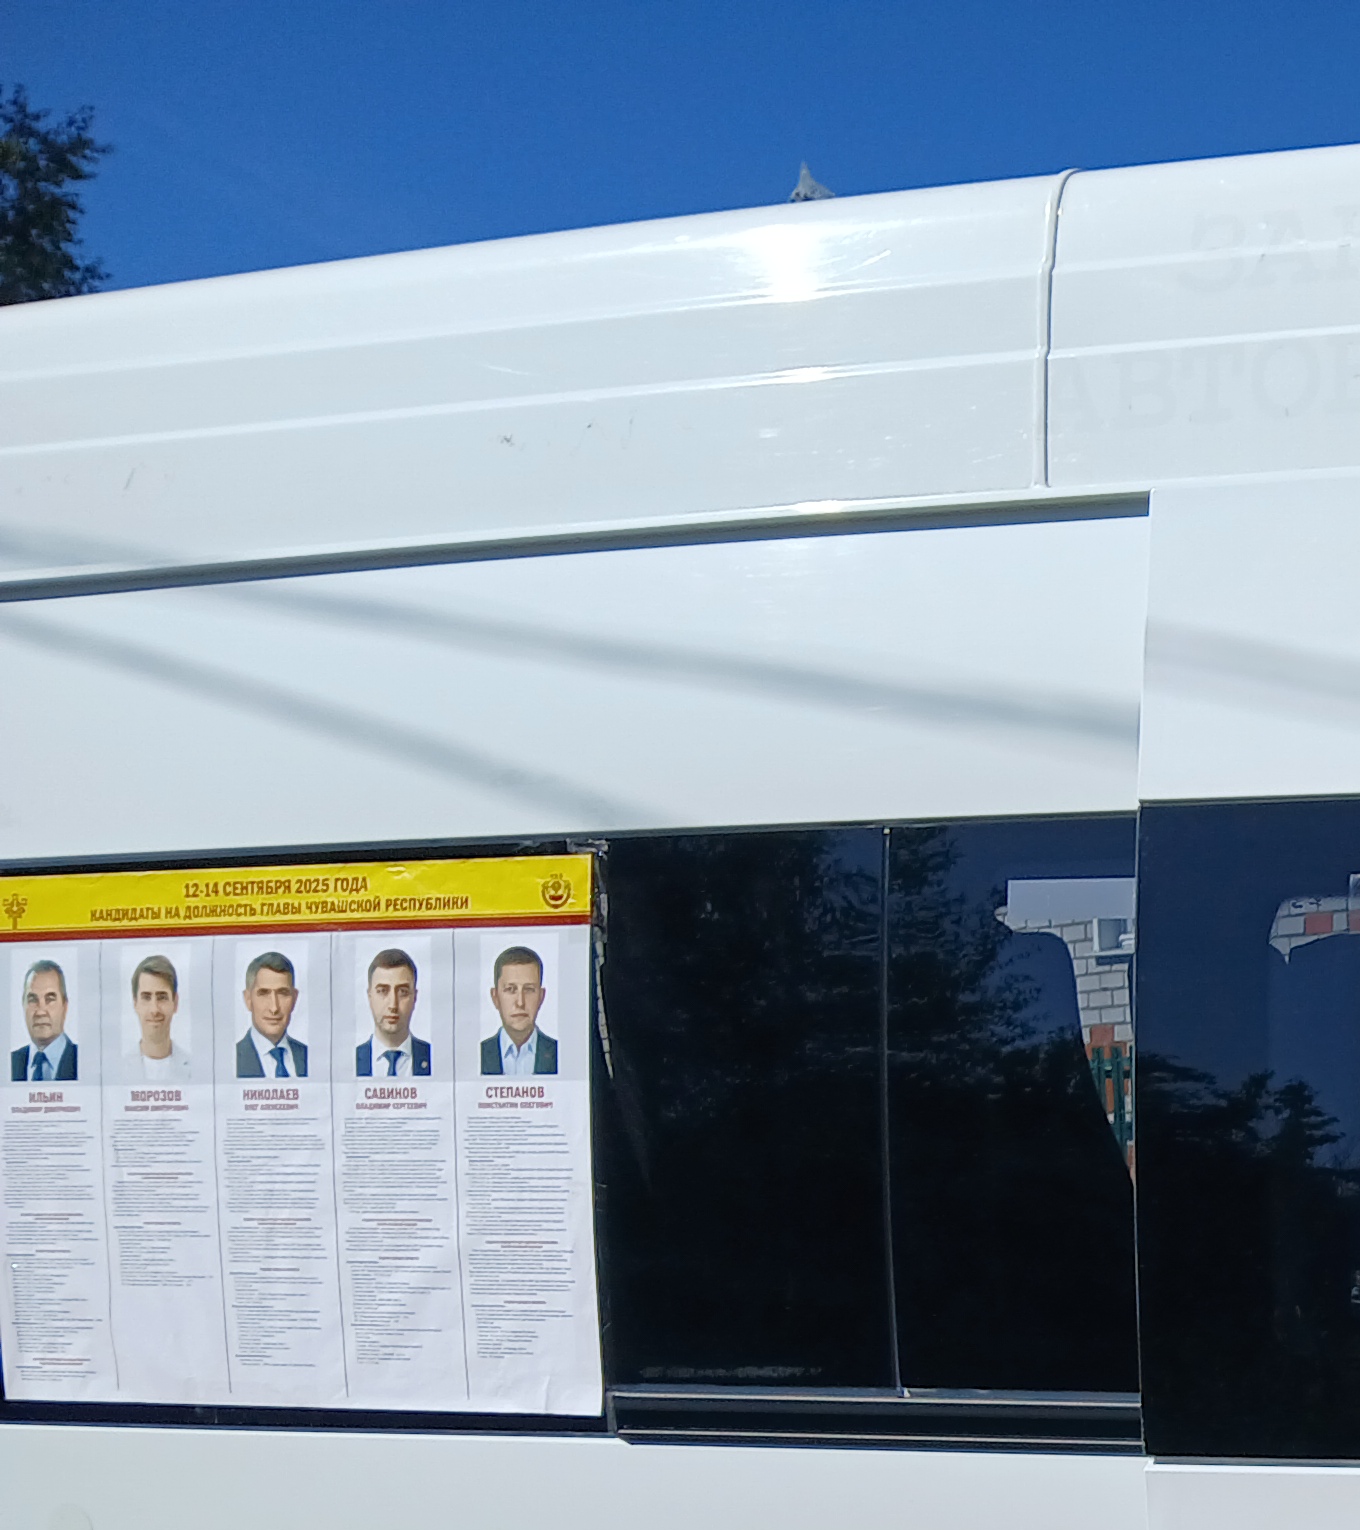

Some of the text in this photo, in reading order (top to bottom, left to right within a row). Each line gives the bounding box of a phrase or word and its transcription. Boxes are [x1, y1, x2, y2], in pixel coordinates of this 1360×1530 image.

[184, 876, 369, 898] 12-14 СЕНТЯБРЯ 2025 ГОДА
[90, 895, 469, 923] КАНДИДАТЫ НА ДОЛЖНОСТЬ ГЛАВЫ ЧУВАШСКОЙ РЕСПУБЛИКИ
[364, 1086, 418, 1100] САВИНОВ
[485, 1085, 545, 1099] СТЕПАНОВ
